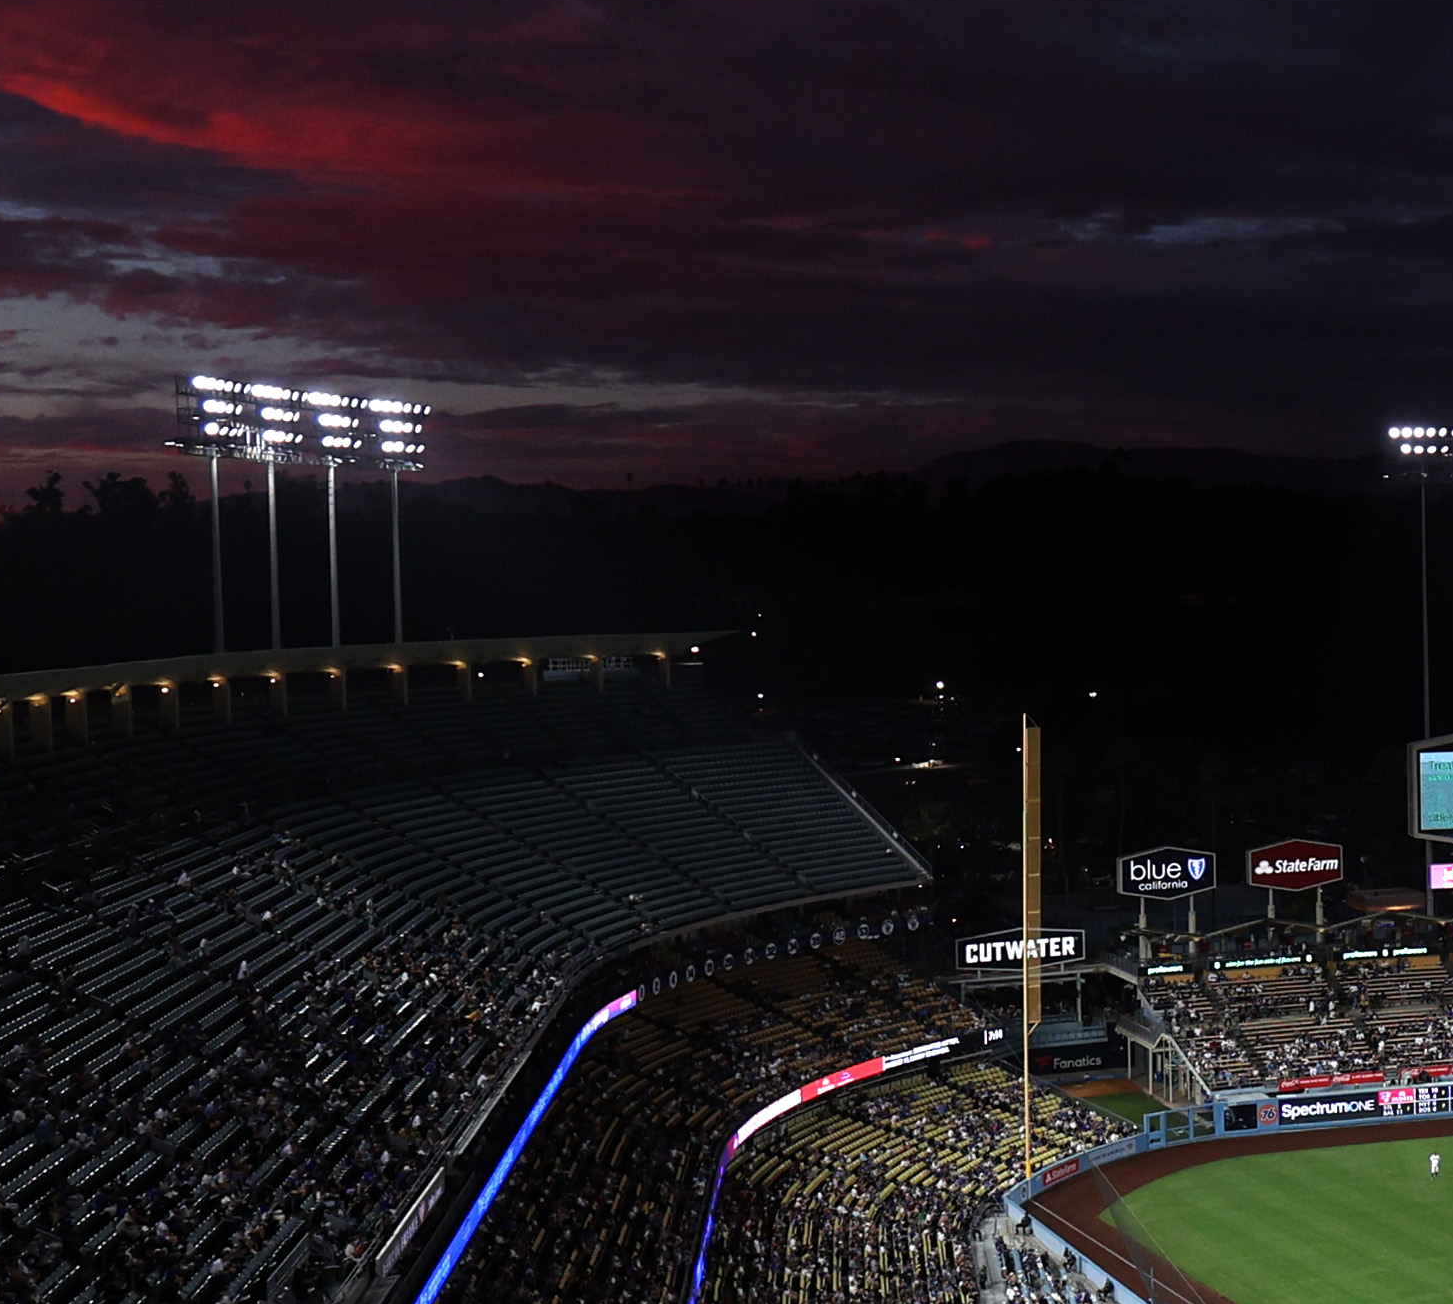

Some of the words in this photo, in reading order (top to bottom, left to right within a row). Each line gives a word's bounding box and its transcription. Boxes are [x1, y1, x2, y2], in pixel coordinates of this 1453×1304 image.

[1130, 859, 1182, 880] blue
[1138, 879, 1188, 891] california
[966, 936, 1076, 964] CUTWATER
[1054, 1055, 1102, 1069] Fanatics
[1260, 1107, 1275, 1121] 76
